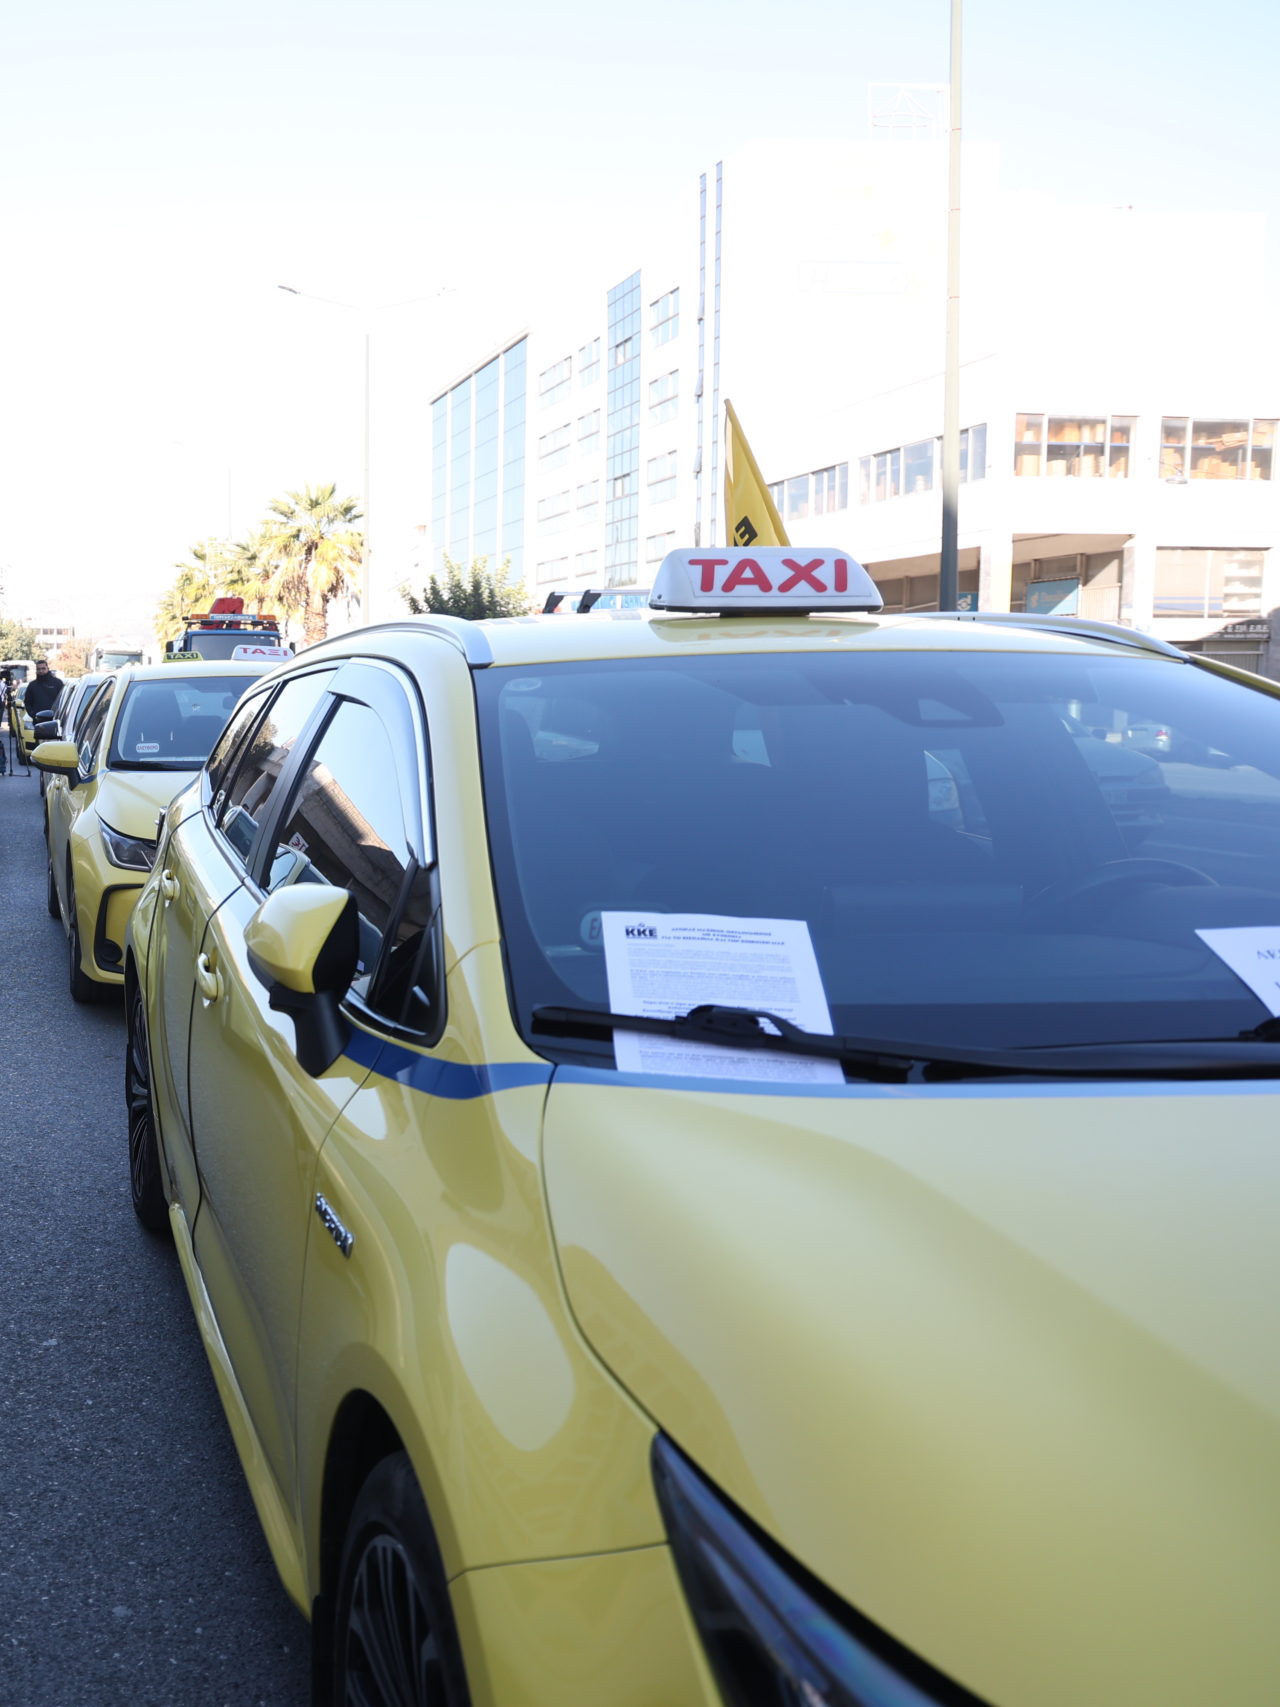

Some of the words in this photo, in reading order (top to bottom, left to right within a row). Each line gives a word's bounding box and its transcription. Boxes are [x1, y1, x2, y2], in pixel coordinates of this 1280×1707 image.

[688, 558, 848, 593] TAXI
[169, 652, 198, 660] TAXI
[239, 647, 288, 657] ΤΑΞΙ
